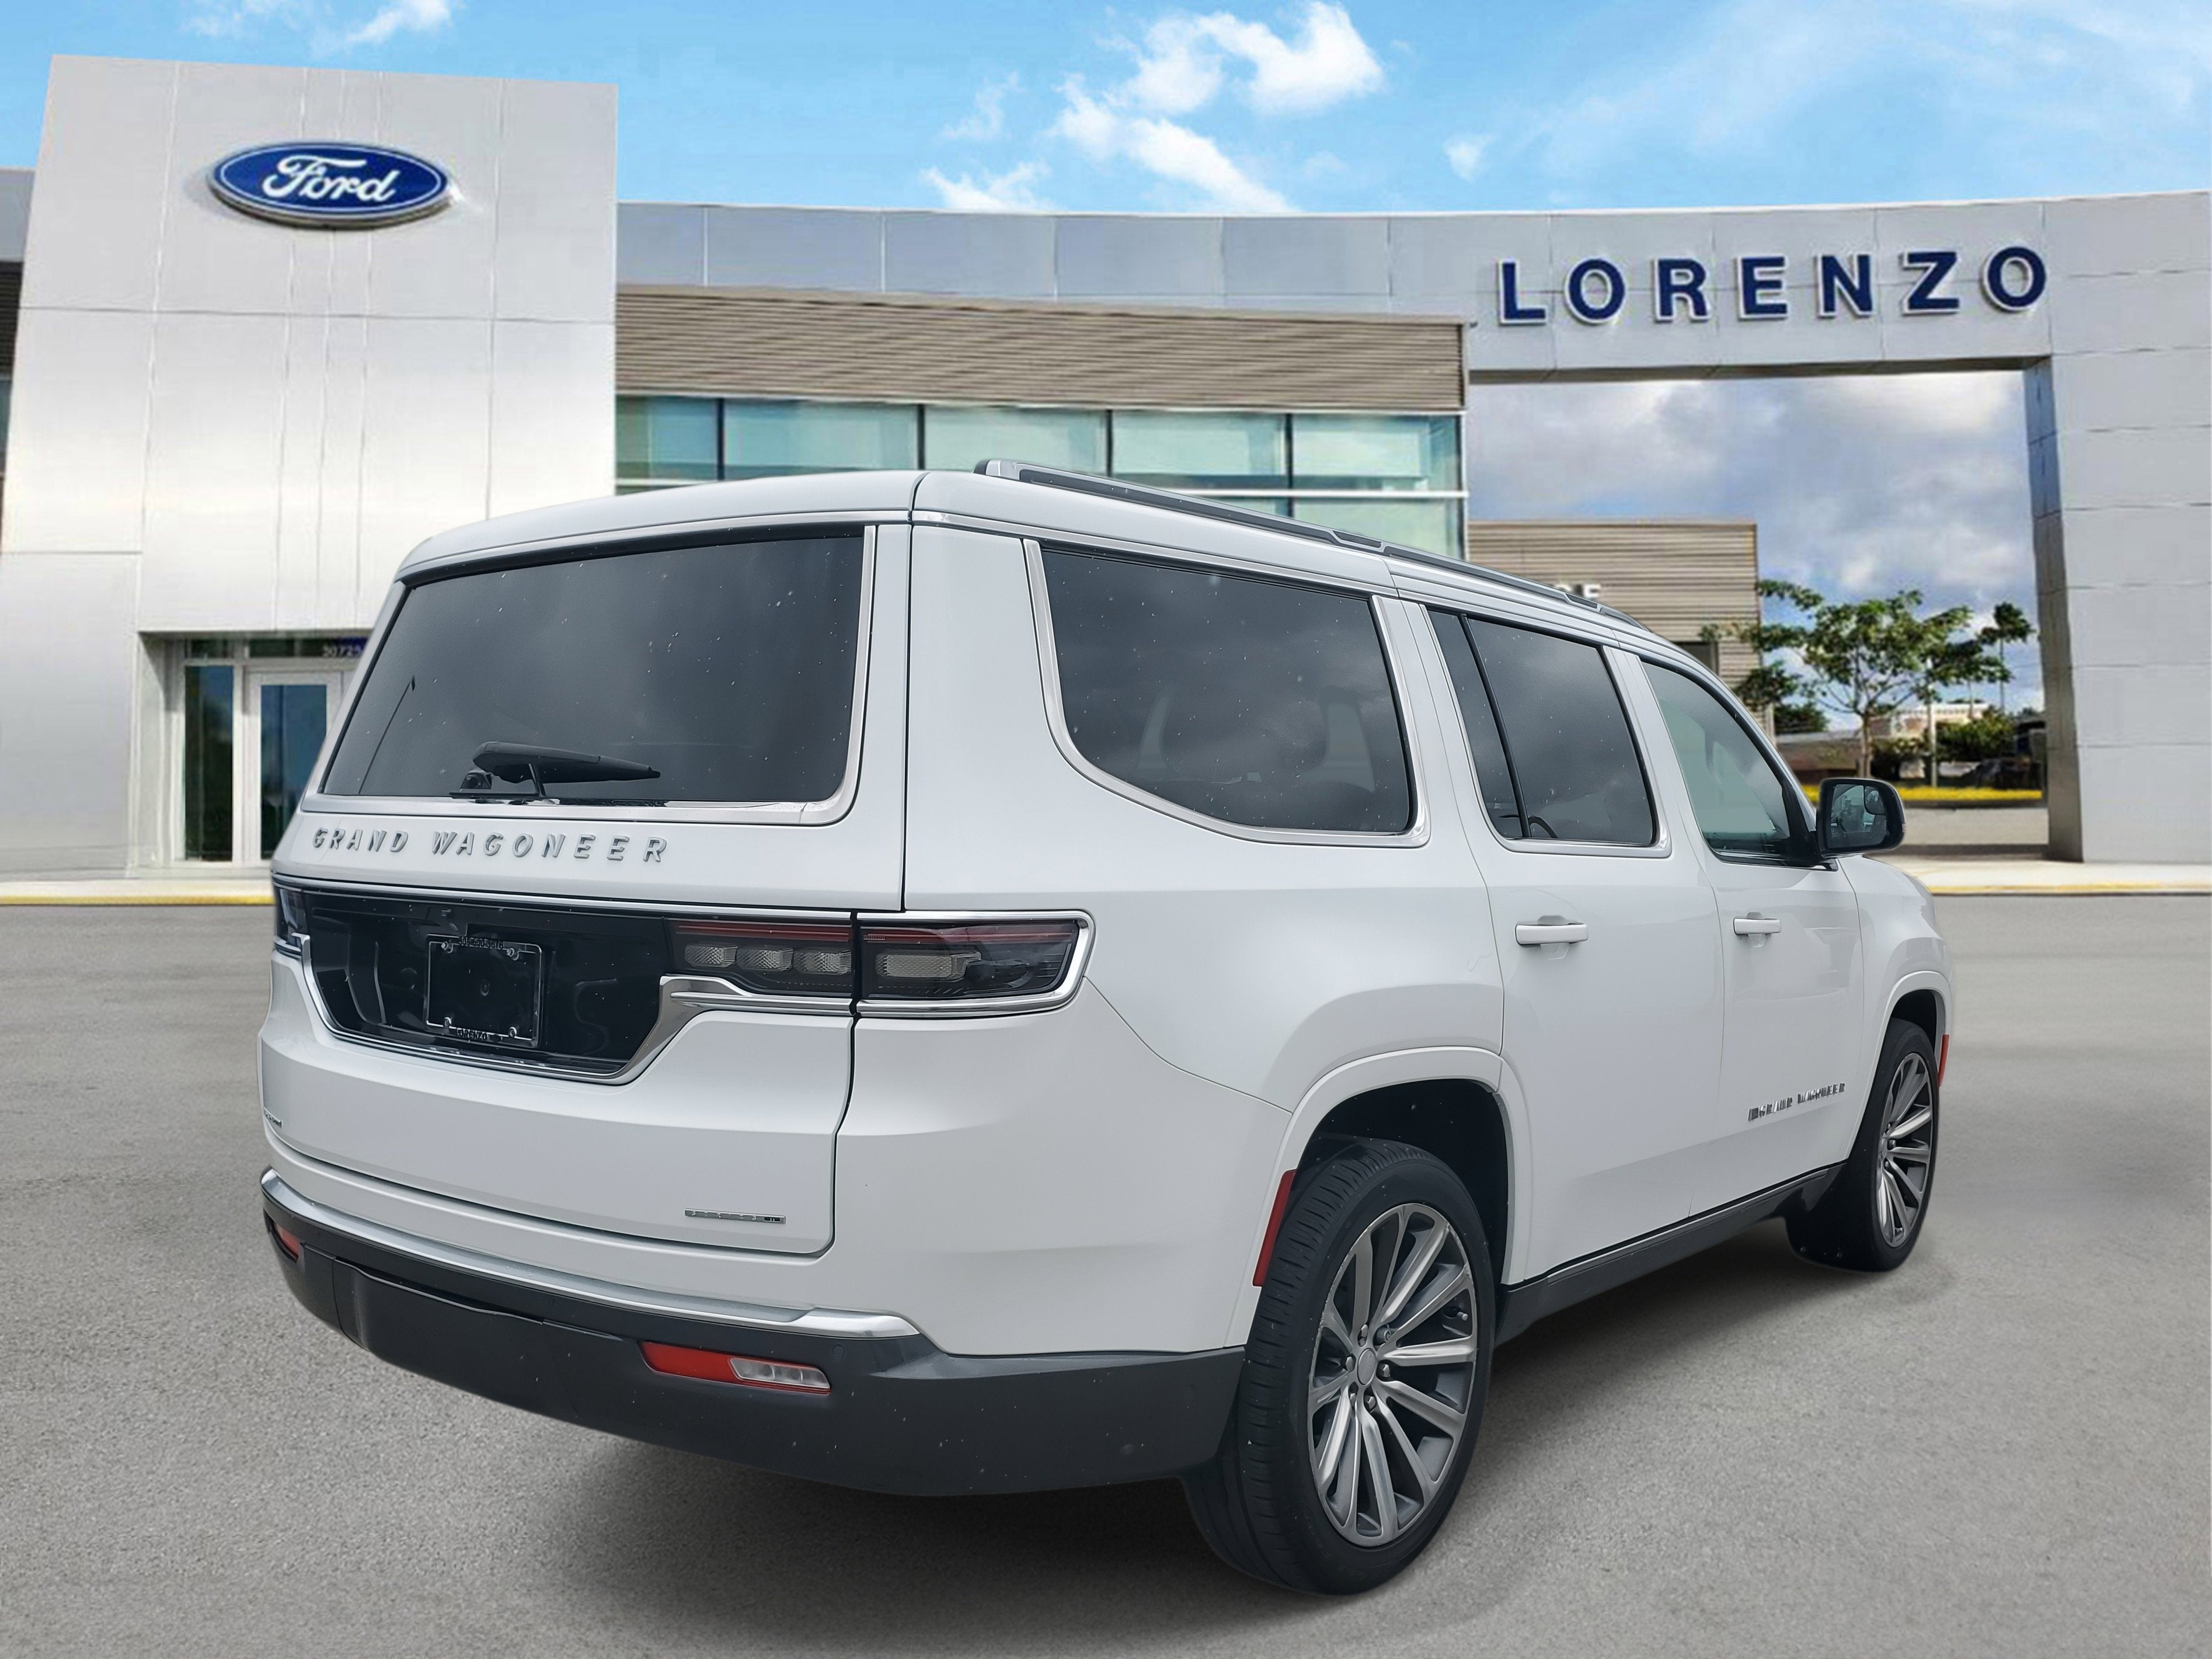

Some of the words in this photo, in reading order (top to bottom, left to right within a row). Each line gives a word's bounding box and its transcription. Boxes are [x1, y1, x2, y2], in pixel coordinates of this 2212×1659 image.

[262, 154, 400, 202] Ford
[1499, 246, 2047, 324] LORENZO
[312, 826, 409, 853] GRAND
[431, 831, 667, 862] WAGONEER
